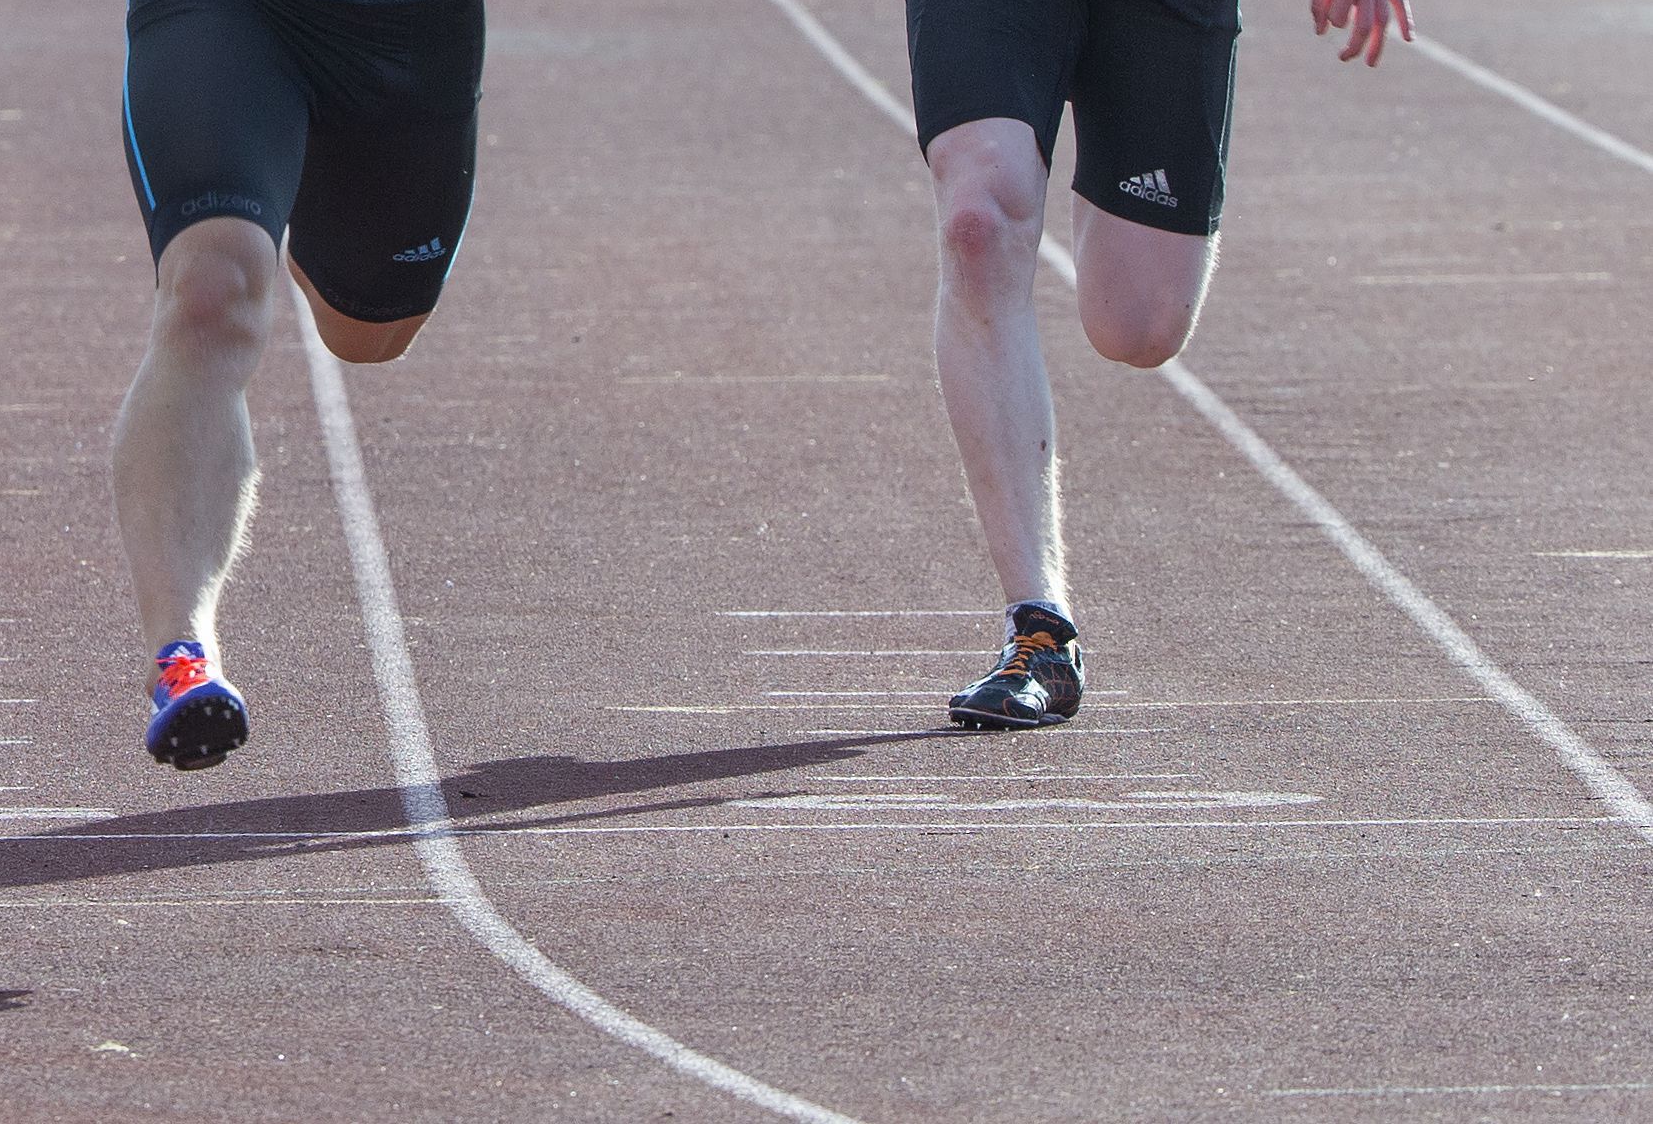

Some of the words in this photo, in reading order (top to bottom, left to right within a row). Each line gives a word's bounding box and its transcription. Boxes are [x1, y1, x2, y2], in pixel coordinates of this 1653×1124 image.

[180, 190, 262, 216] adizero
[1119, 180, 1179, 207] adidas
[392, 247, 446, 262] adidas
